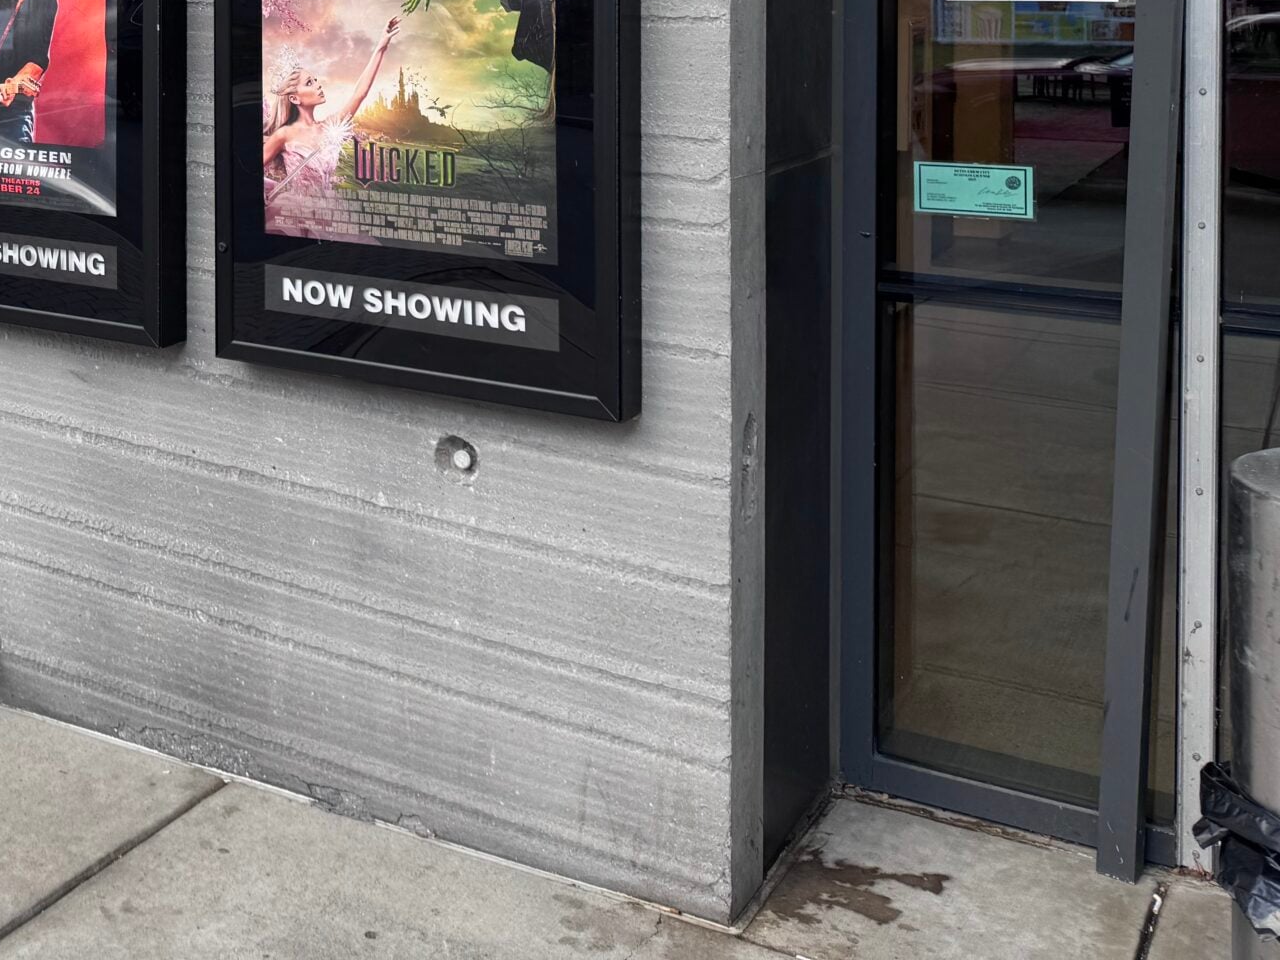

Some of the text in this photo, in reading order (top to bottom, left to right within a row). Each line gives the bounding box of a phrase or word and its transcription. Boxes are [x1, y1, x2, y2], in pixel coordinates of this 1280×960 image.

[353, 136, 457, 188] WICKED
[0, 163, 23, 176] FROM
[27, 166, 72, 180] NOWHERE
[1, 177, 41, 187] THEATERS
[26, 186, 41, 195] 24
[282, 276, 527, 333] NOW SHOWING
